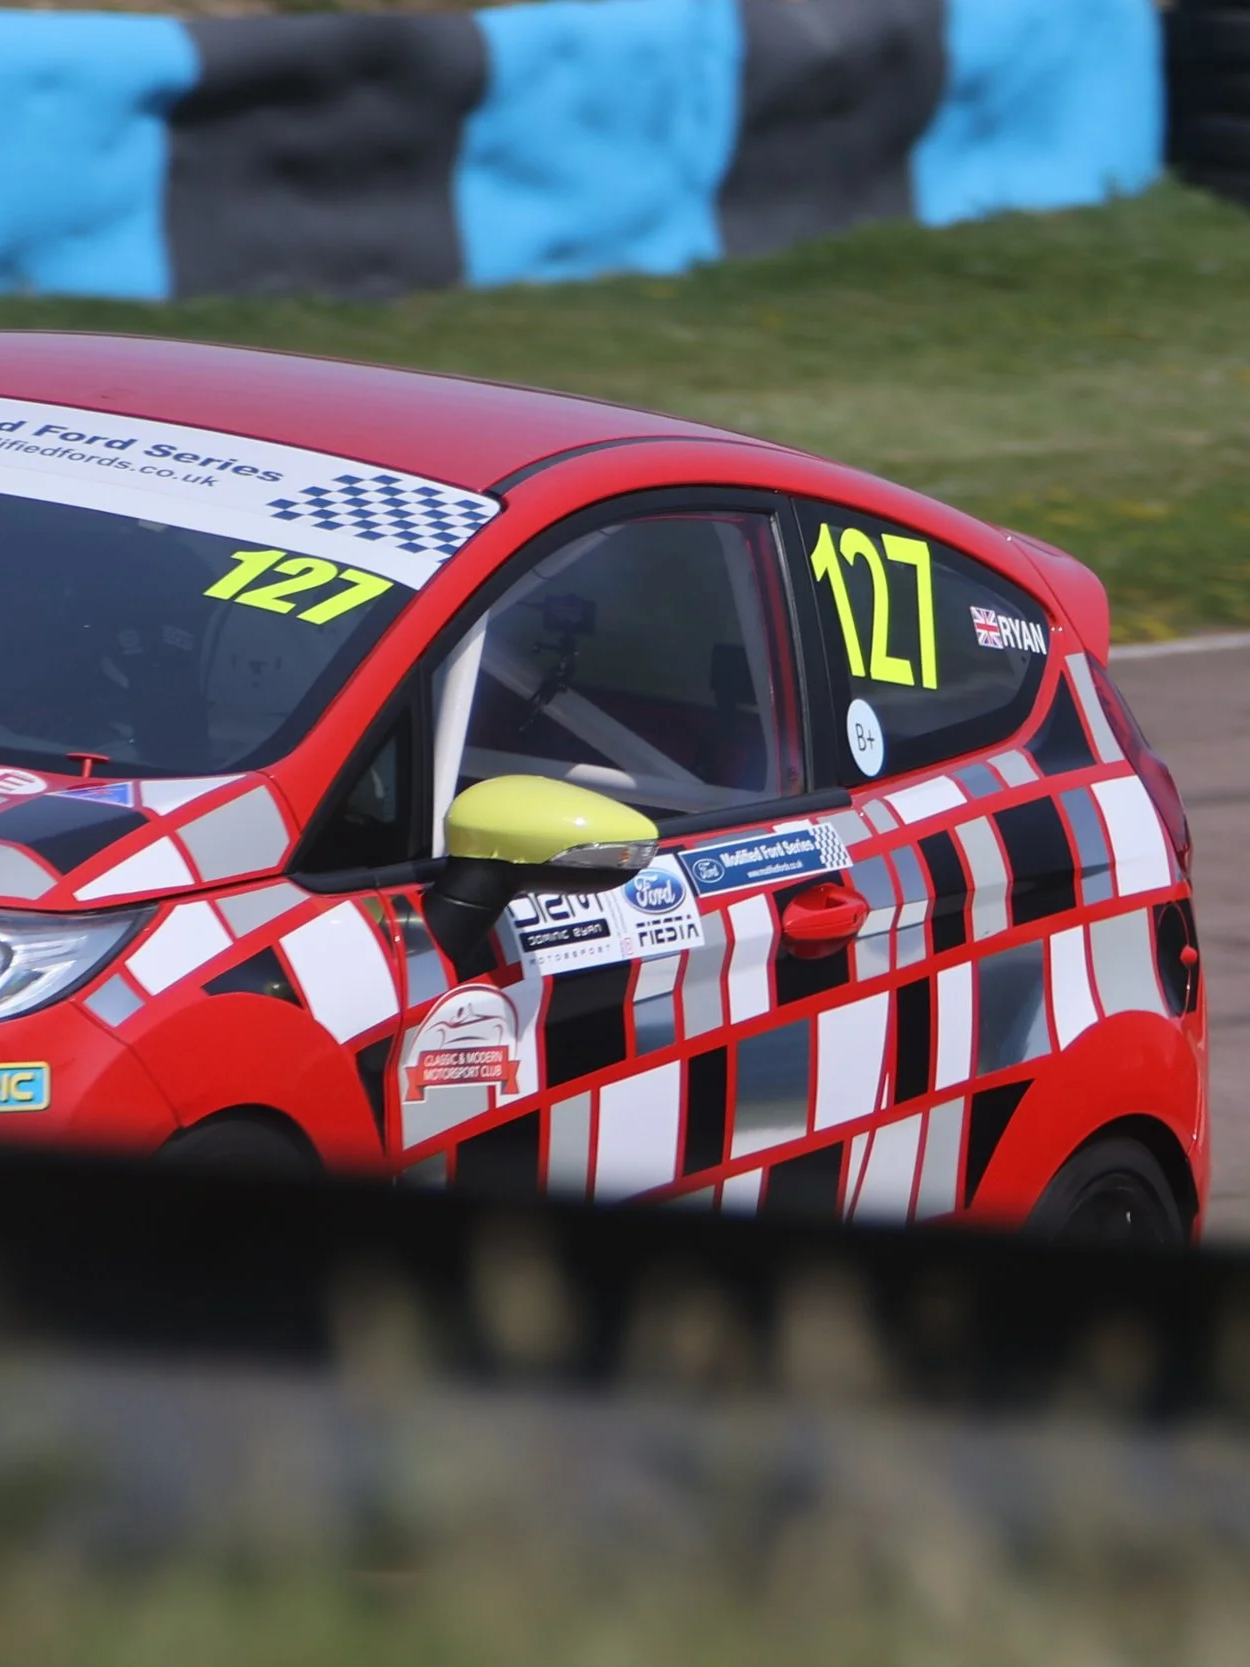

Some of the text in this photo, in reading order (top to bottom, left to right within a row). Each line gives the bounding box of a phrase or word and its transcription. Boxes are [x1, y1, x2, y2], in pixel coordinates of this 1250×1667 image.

[33, 424, 138, 451] Ford
[143, 443, 285, 483] Series
[203, 550, 395, 625] 127
[810, 523, 937, 689] 127
[997, 615, 1047, 655] RYAN
[855, 723, 875, 751] B+
[719, 838, 815, 868] Modified Ford Series
[698, 861, 720, 880] Ford
[634, 875, 676, 907] Ford
[636, 914, 700, 947] FIESTA
[529, 944, 612, 966] MOTORSPORT
[423, 1050, 503, 1067] CLASSIC & MODERN
[423, 1063, 502, 1081] MOTORSPORT CLUB
